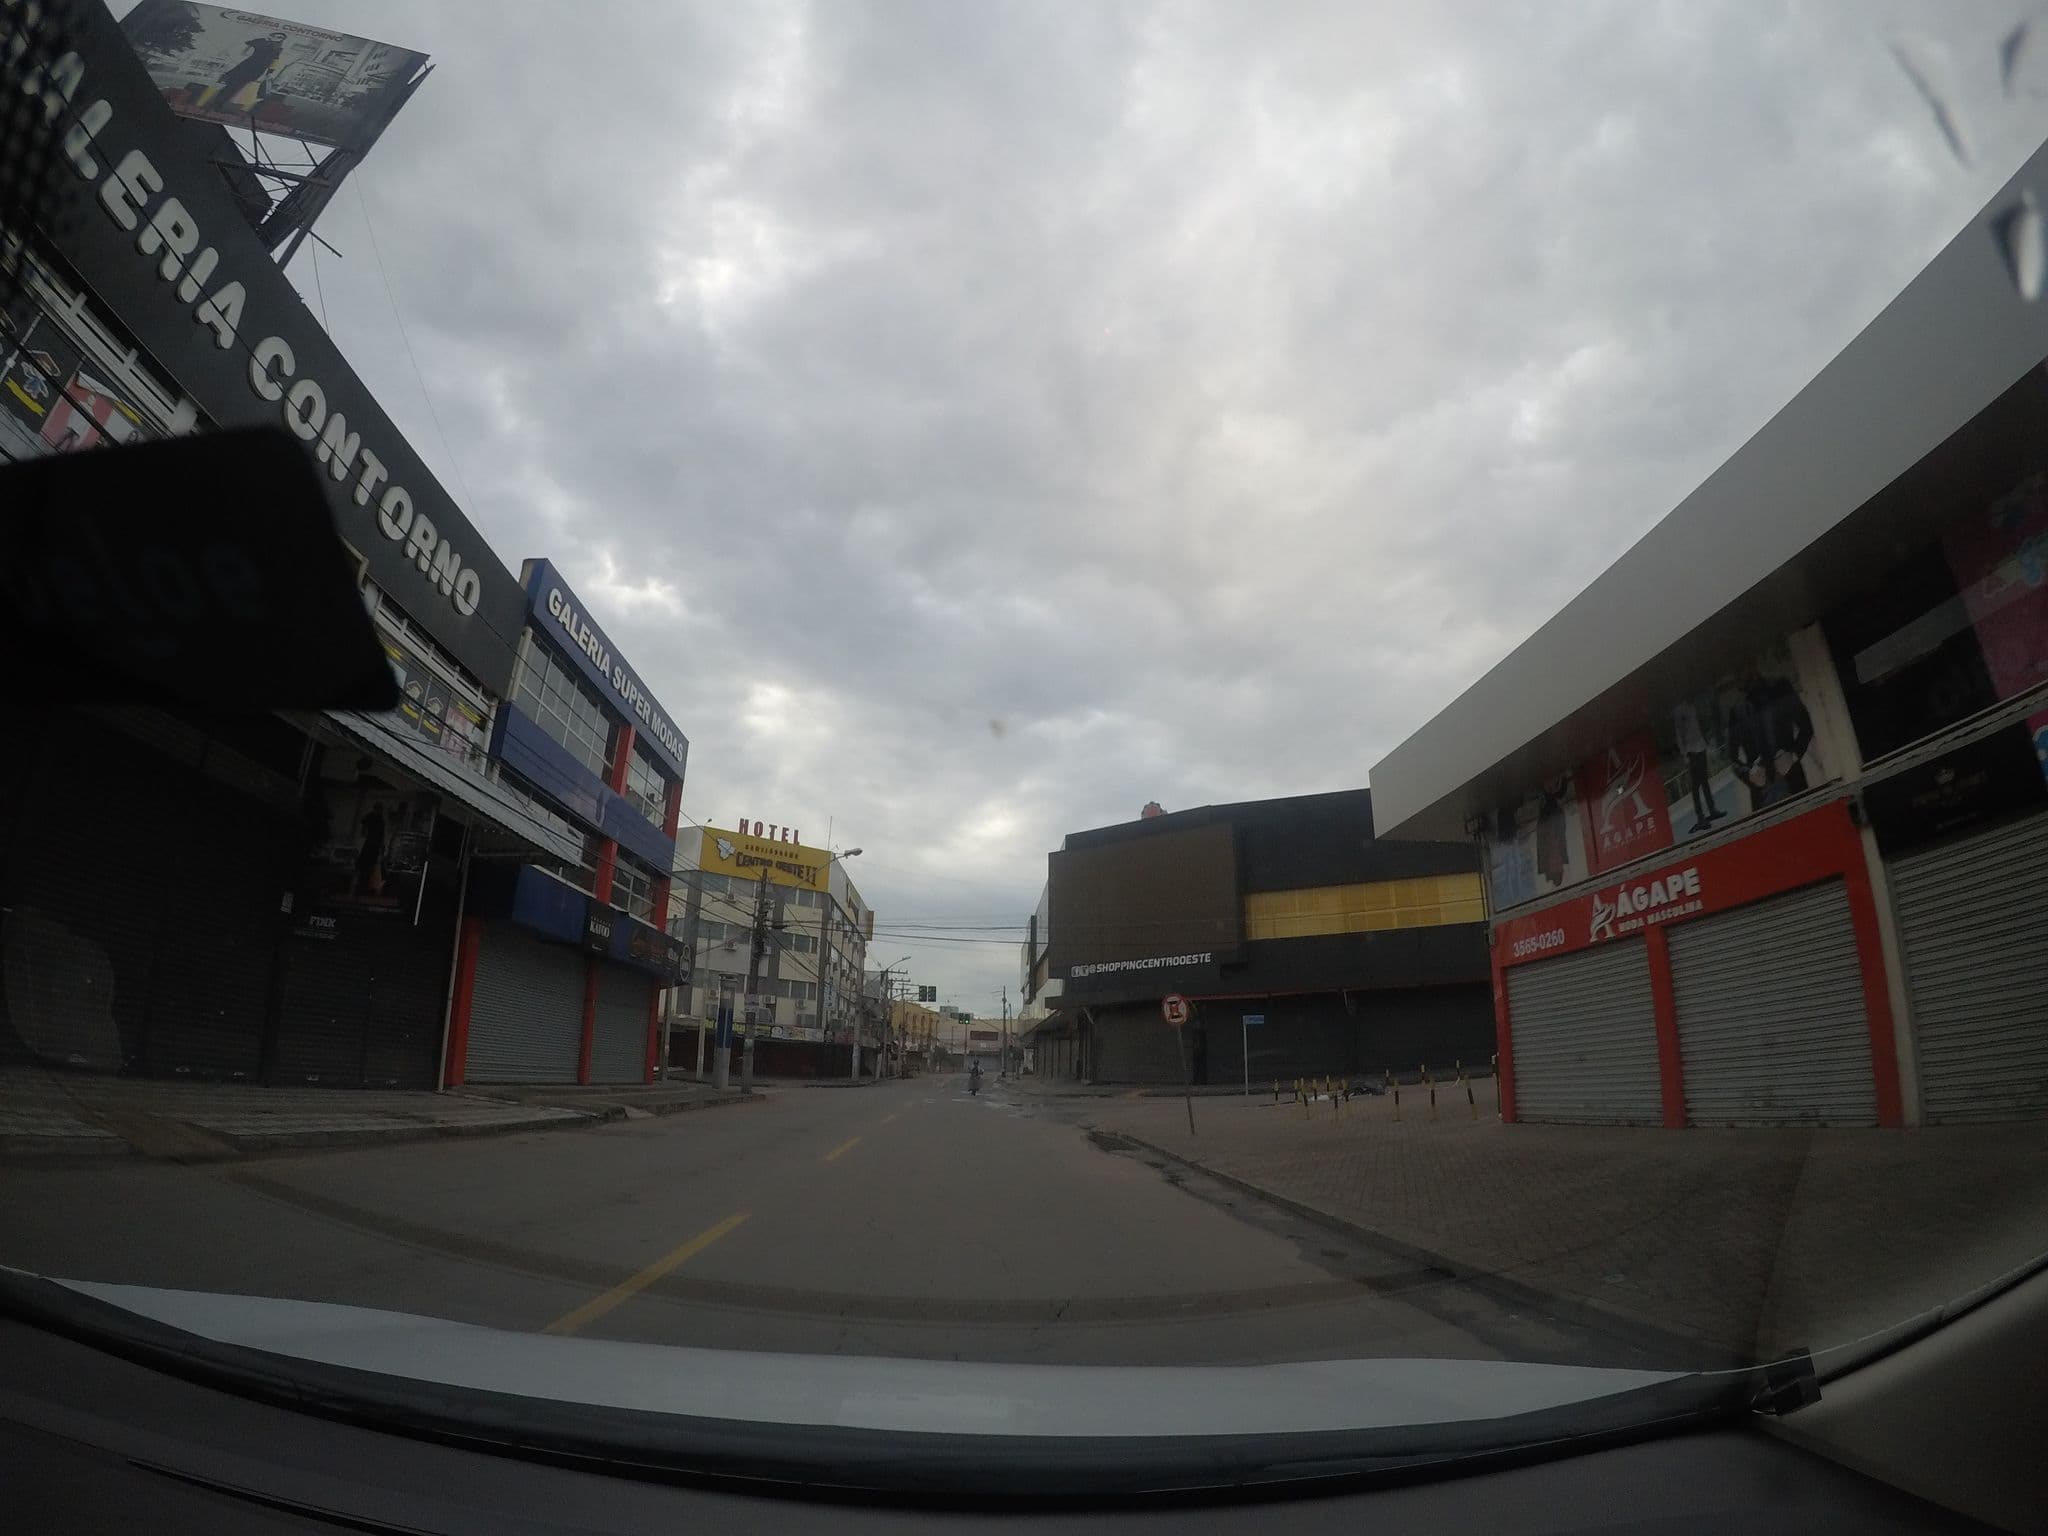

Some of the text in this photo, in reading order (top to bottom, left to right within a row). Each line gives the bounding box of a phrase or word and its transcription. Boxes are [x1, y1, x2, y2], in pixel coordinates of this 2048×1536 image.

[236, 15, 280, 29] GALERIA
[282, 24, 344, 42] CONTORNO
[248, 335, 482, 617] CONTORNO
[548, 587, 685, 763] GALERIA SUPER MODAS
[738, 818, 800, 846] HOTEL
[736, 851, 773, 868] CENTRO
[1616, 867, 1701, 918] ÁGAPE
[1646, 900, 1703, 925] MASCULINA
[1512, 928, 1565, 957] 3565-0260
